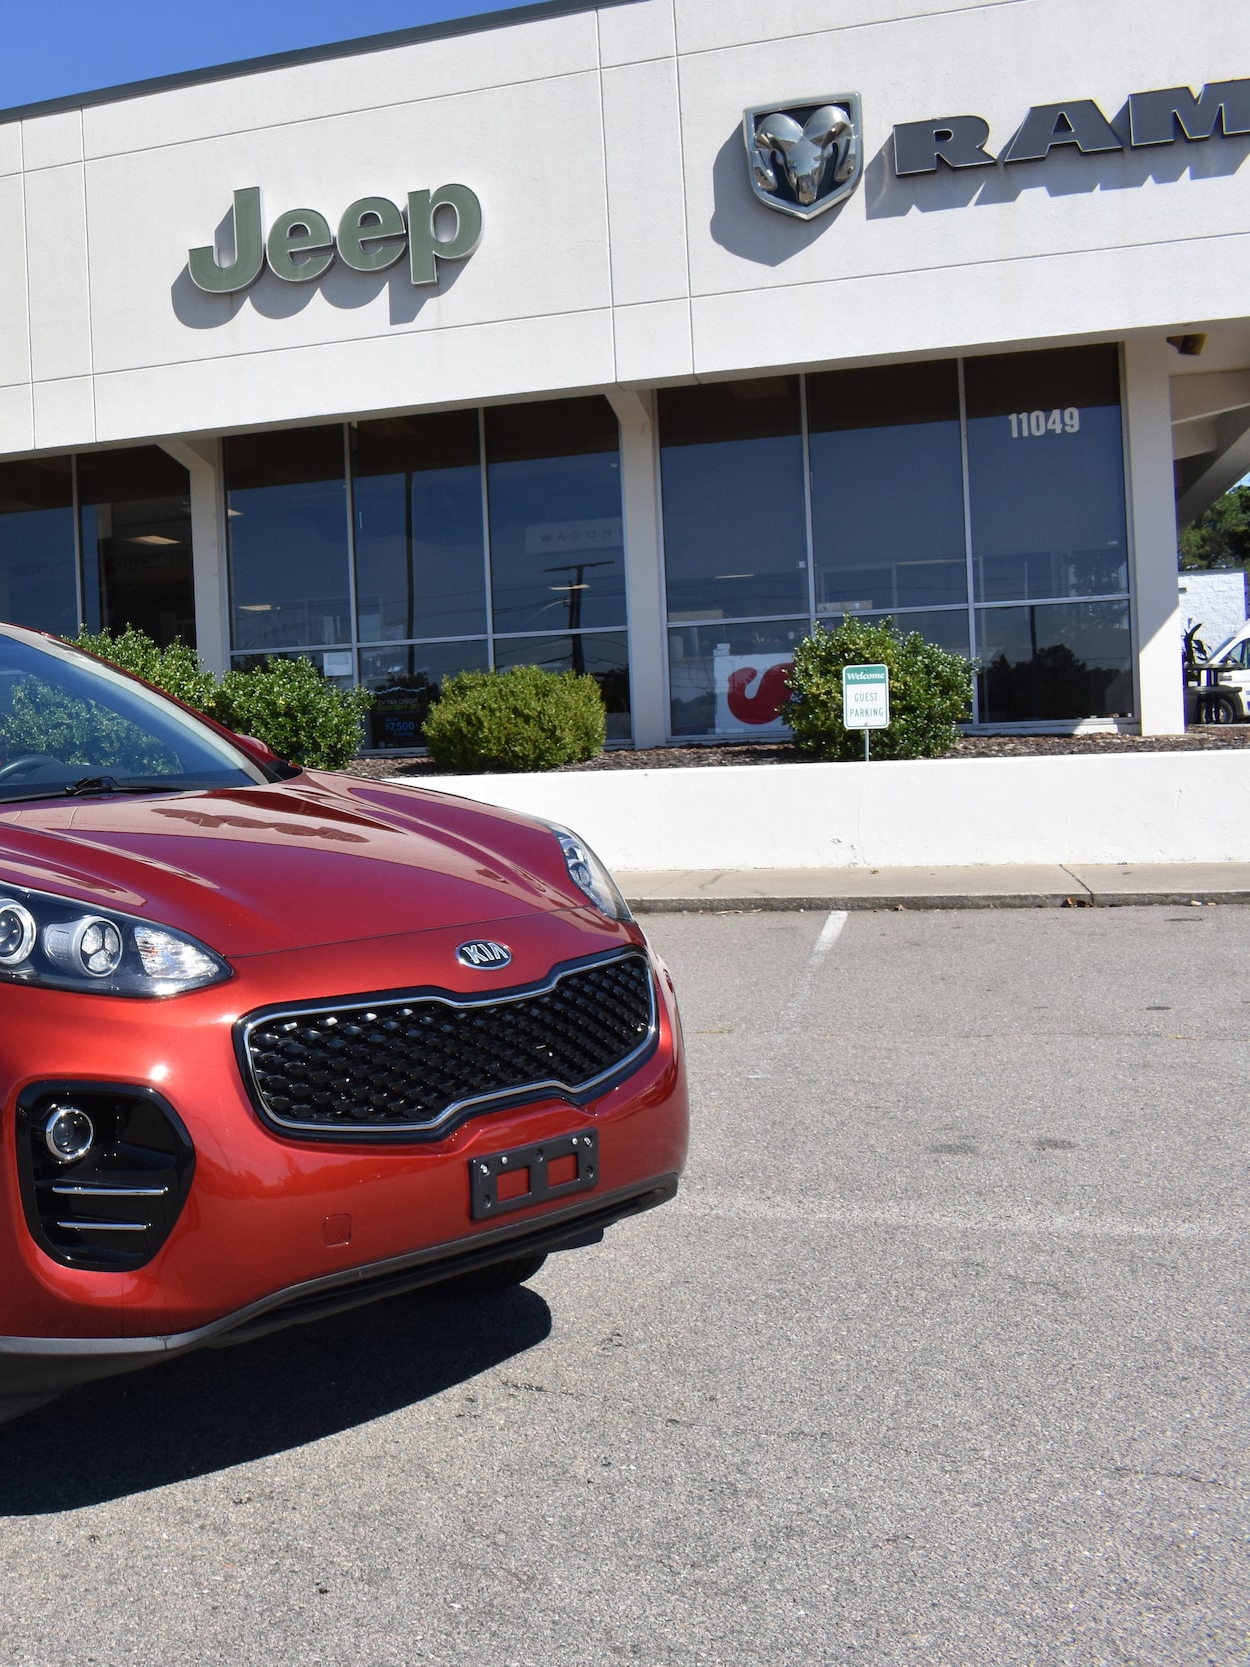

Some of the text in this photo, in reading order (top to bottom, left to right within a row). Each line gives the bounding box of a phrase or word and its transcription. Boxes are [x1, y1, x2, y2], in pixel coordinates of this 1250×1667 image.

[893, 78, 1250, 177] RAM
[188, 183, 484, 294] Jeep
[1008, 407, 1080, 438] 11049
[847, 672, 885, 680] Welcome
[854, 692, 878, 702] GUEST
[850, 707, 883, 717] PARKING
[462, 942, 509, 965] KIA
